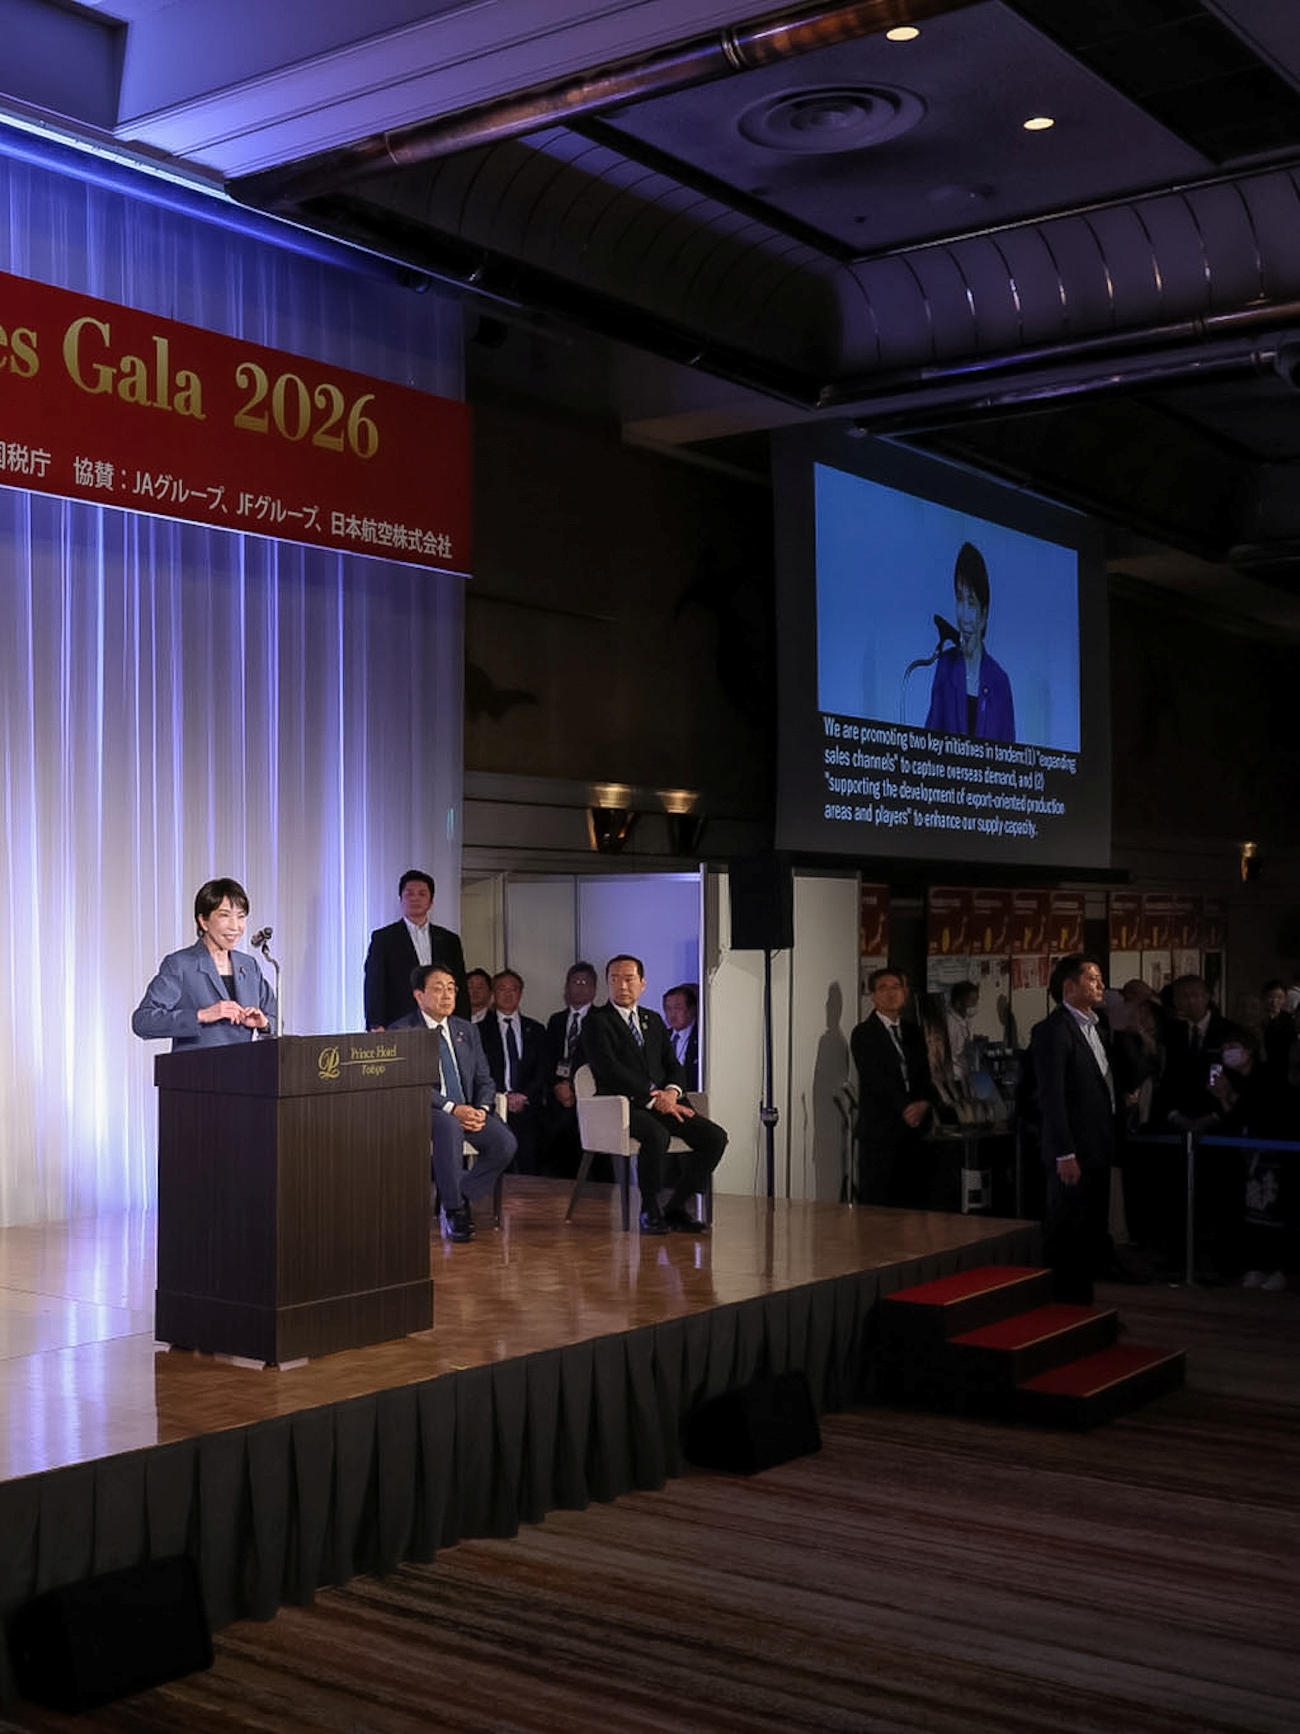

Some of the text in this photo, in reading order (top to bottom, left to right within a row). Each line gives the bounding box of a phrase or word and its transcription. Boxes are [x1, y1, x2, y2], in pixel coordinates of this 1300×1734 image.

[62, 315, 207, 421] Gala
[233, 362, 381, 459] 2026
[823, 716, 841, 738] We
[842, 724, 860, 740] are
[860, 727, 909, 752] promoting
[909, 731, 927, 750] two
[927, 732, 944, 756] key
[824, 745, 851, 766] sales
[900, 756, 911, 774] to
[911, 758, 946, 779] capture
[1018, 771, 1033, 789] and
[881, 777, 899, 798] the
[899, 780, 956, 805] development
[824, 803, 853, 821] areas
[854, 803, 873, 822] and
[913, 808, 923, 827] to
[923, 809, 961, 831] enhance
[961, 815, 976, 831] our
[976, 815, 1004, 837] supply
[351, 1044, 397, 1060] Prince Hotel
[362, 1064, 385, 1076] Tokyo
